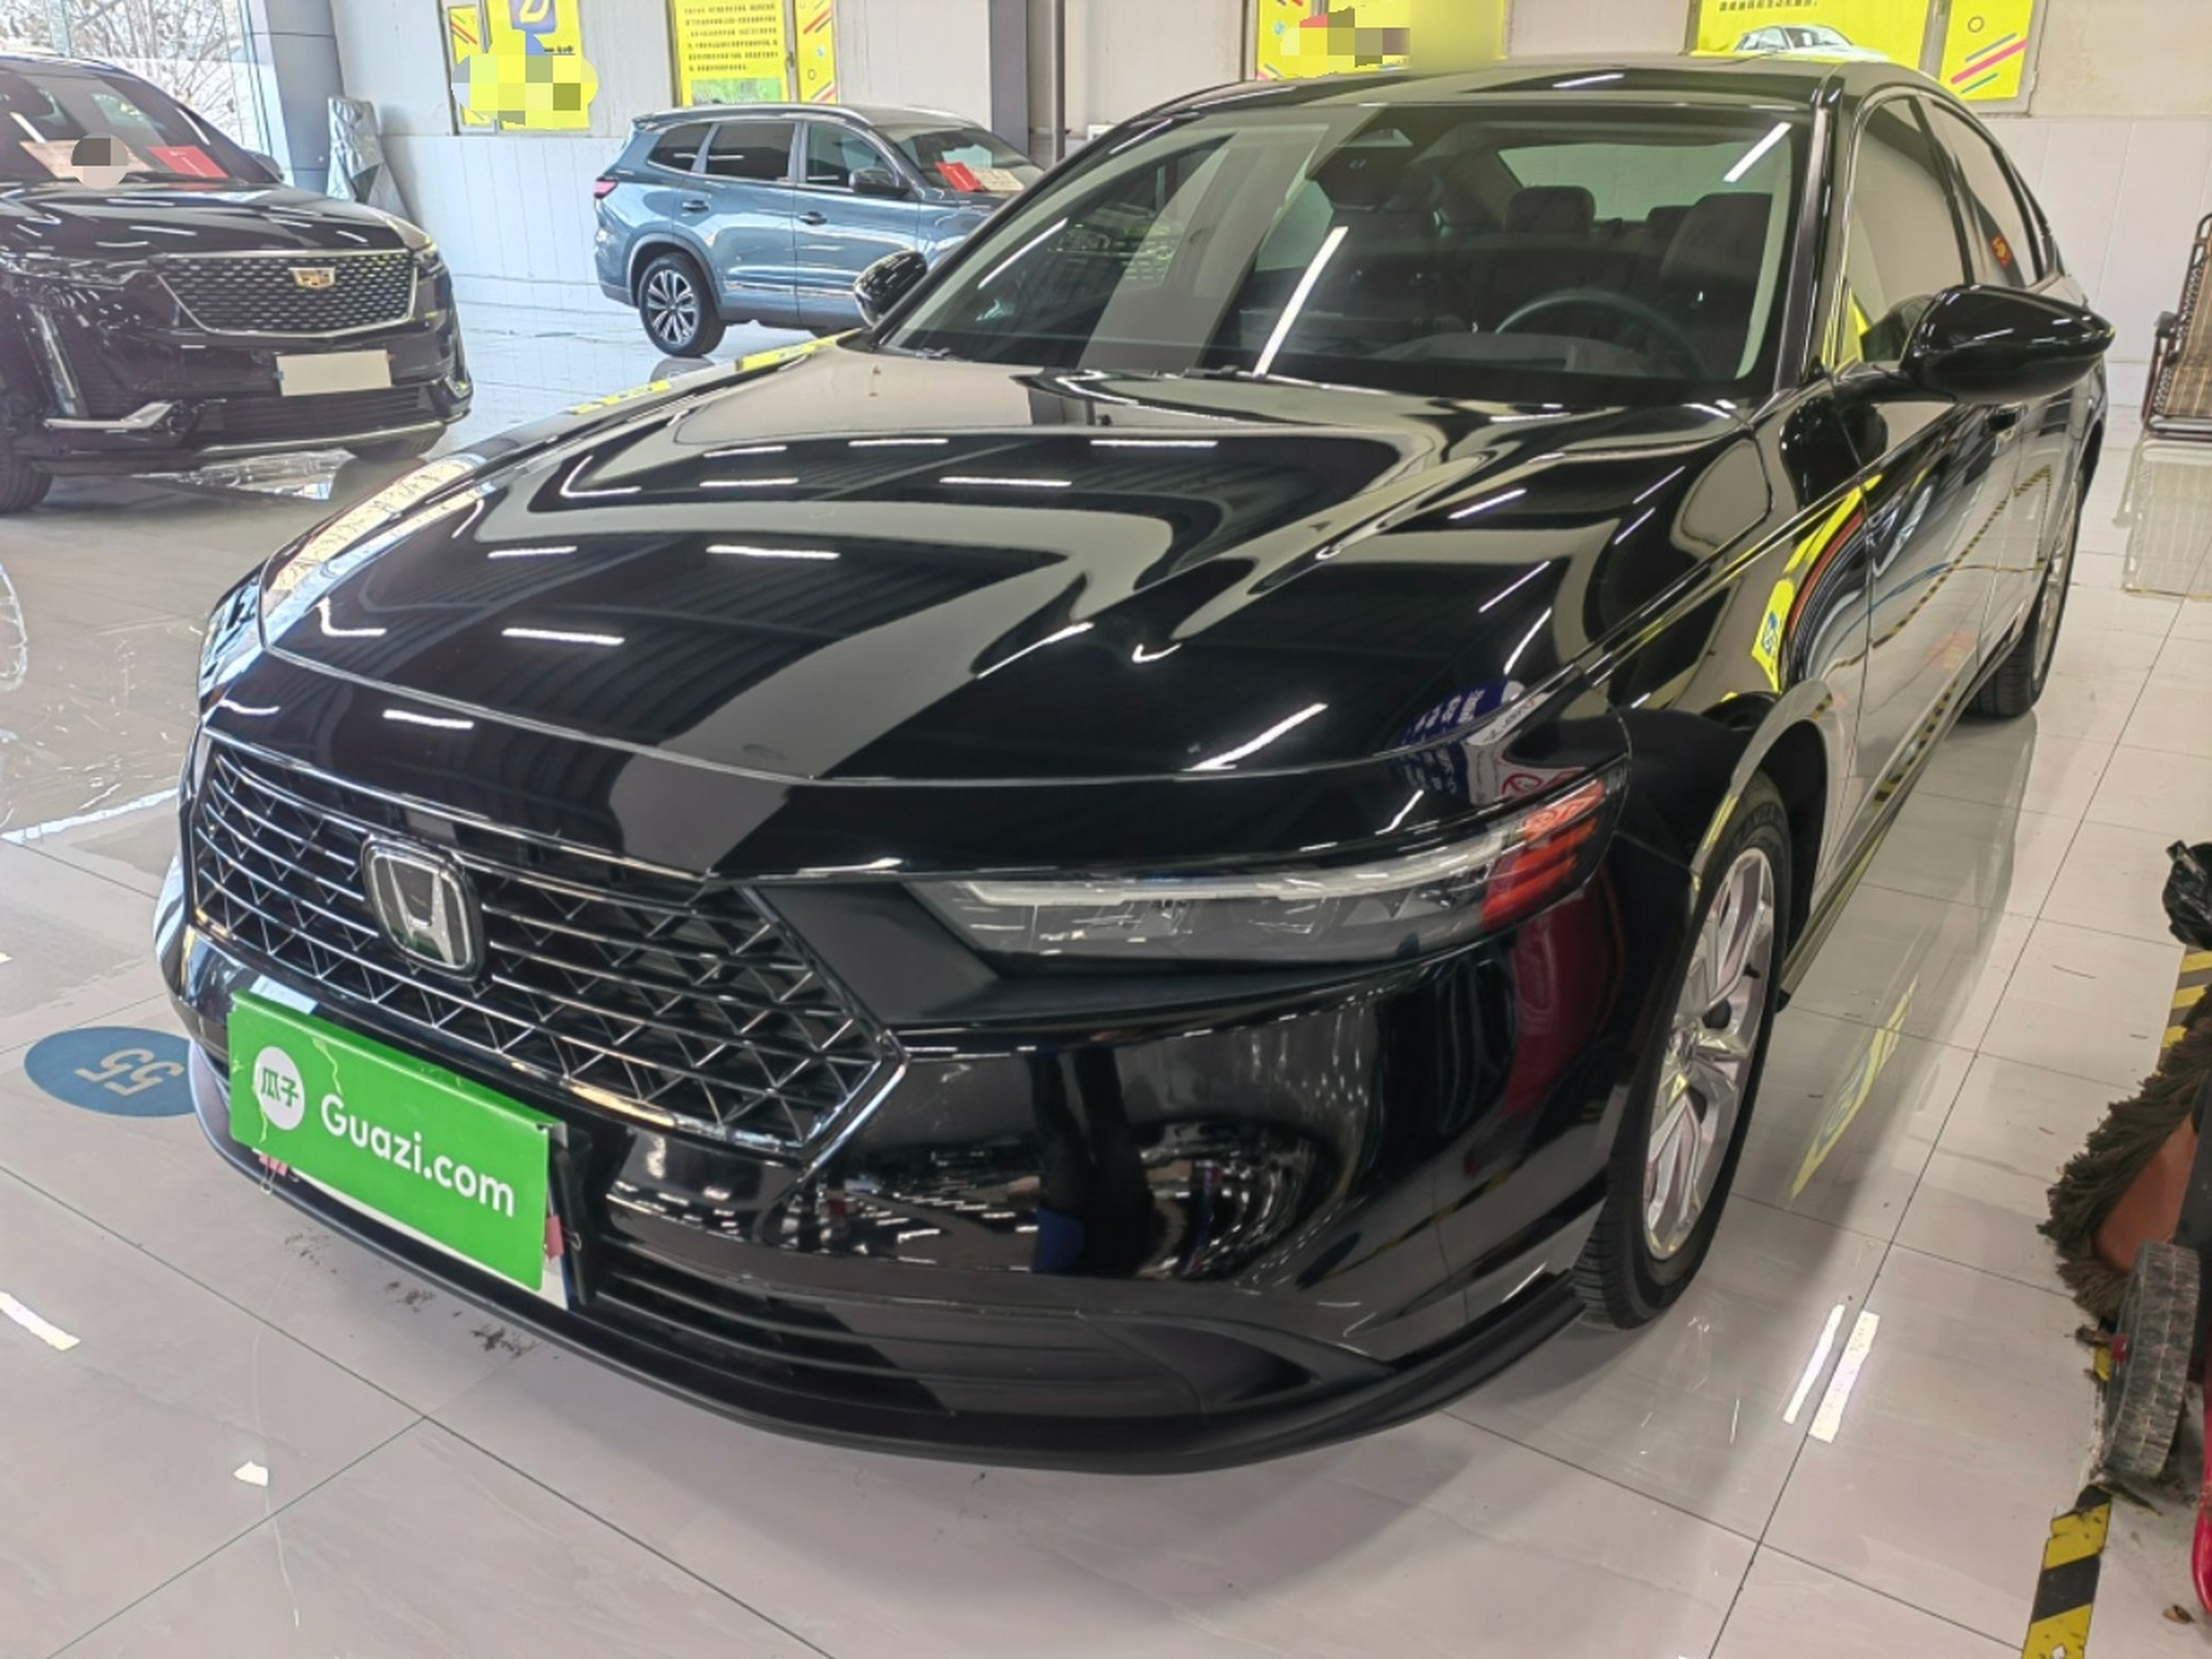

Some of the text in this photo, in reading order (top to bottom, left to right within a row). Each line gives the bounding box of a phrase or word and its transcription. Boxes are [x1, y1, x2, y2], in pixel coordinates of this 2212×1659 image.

[75, 1049, 184, 1096] 55
[260, 1067, 300, 1108] 瓜子
[321, 1094, 514, 1217] Guazi.com
